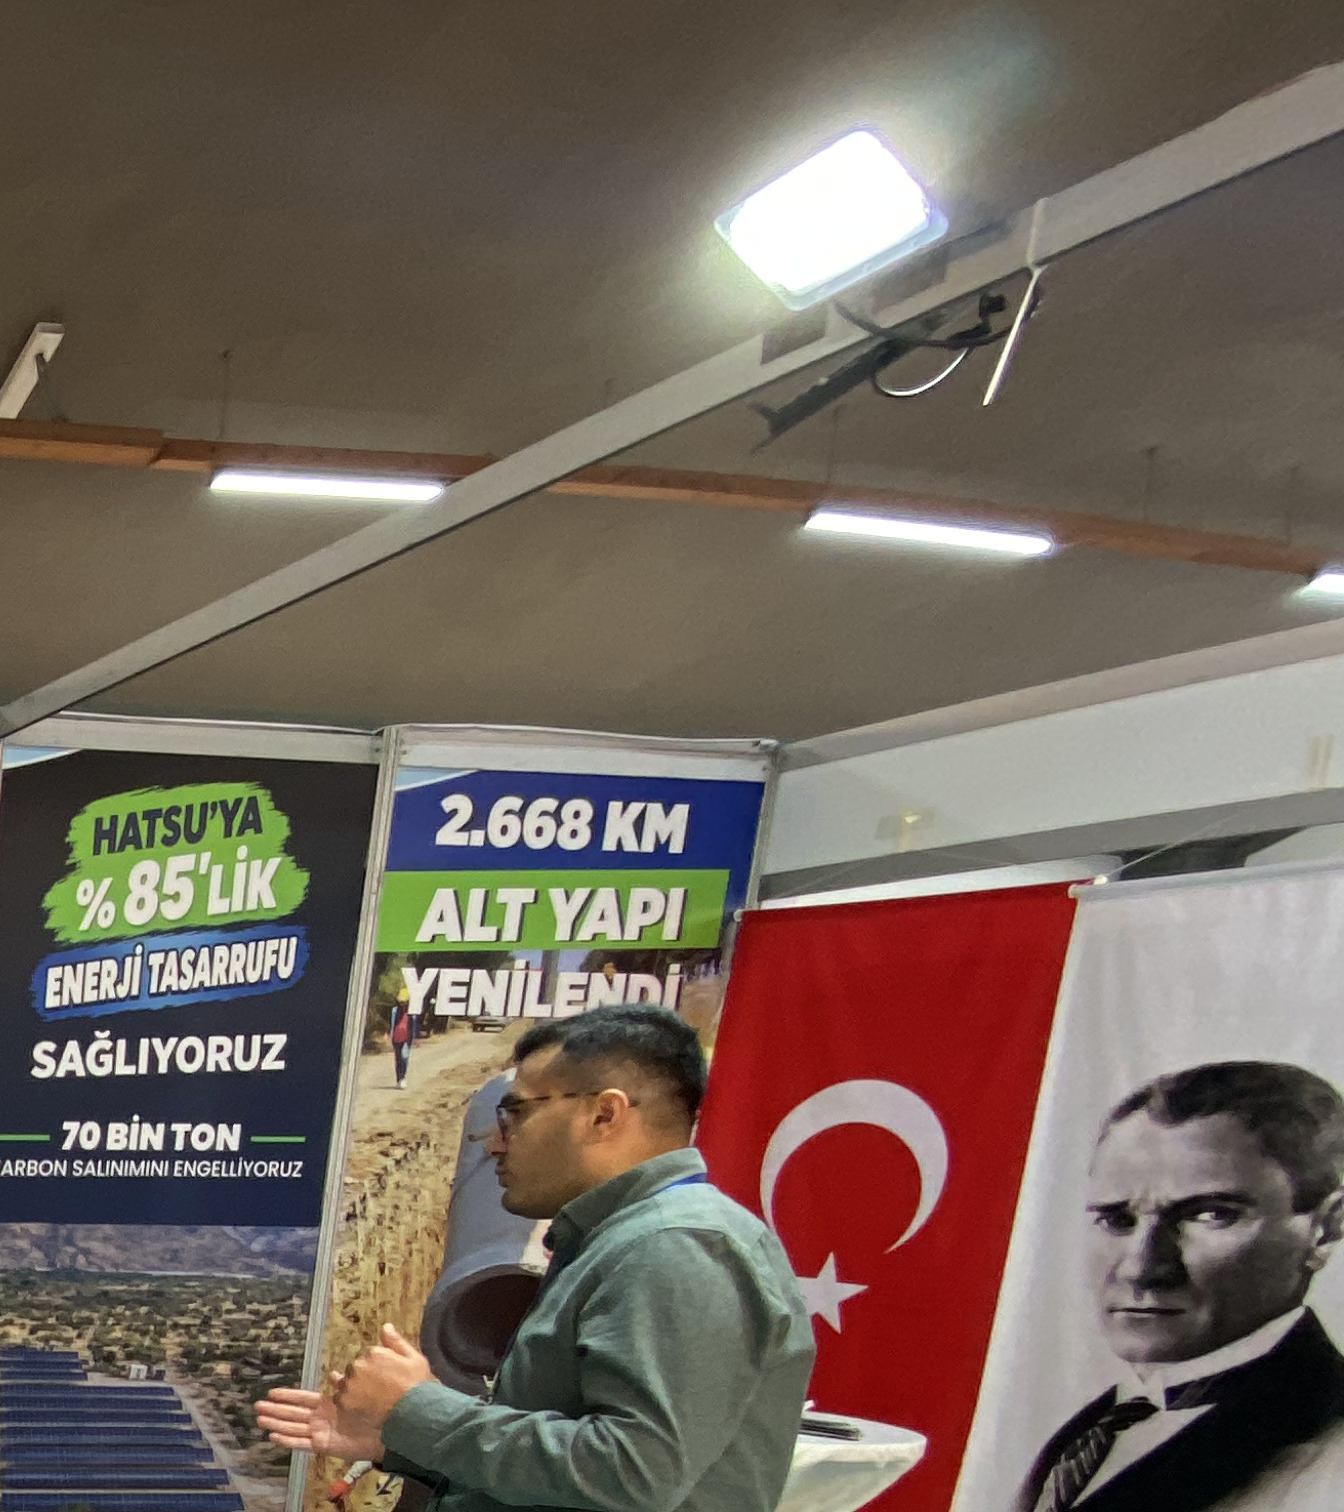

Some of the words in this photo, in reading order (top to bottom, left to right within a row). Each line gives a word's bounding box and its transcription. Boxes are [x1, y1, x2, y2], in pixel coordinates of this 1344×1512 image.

[92, 796, 263, 856] HATSU'YA
[435, 793, 593, 851] 2.668
[602, 801, 690, 854] KM
[415, 887, 538, 943] ALT
[549, 886, 688, 942] YAPI
[44, 944, 144, 1010] ENERJİ
[148, 937, 298, 996] TASARRUFU
[30, 1030, 287, 1079] SAĞLIYORUZ
[61, 1121, 101, 1151] 70
[106, 1114, 164, 1151] BİN
[171, 1123, 241, 1151] TON
[71, 1159, 169, 1178] SALINIMINI
[173, 1156, 303, 1178] ENGELLİYORUZ
